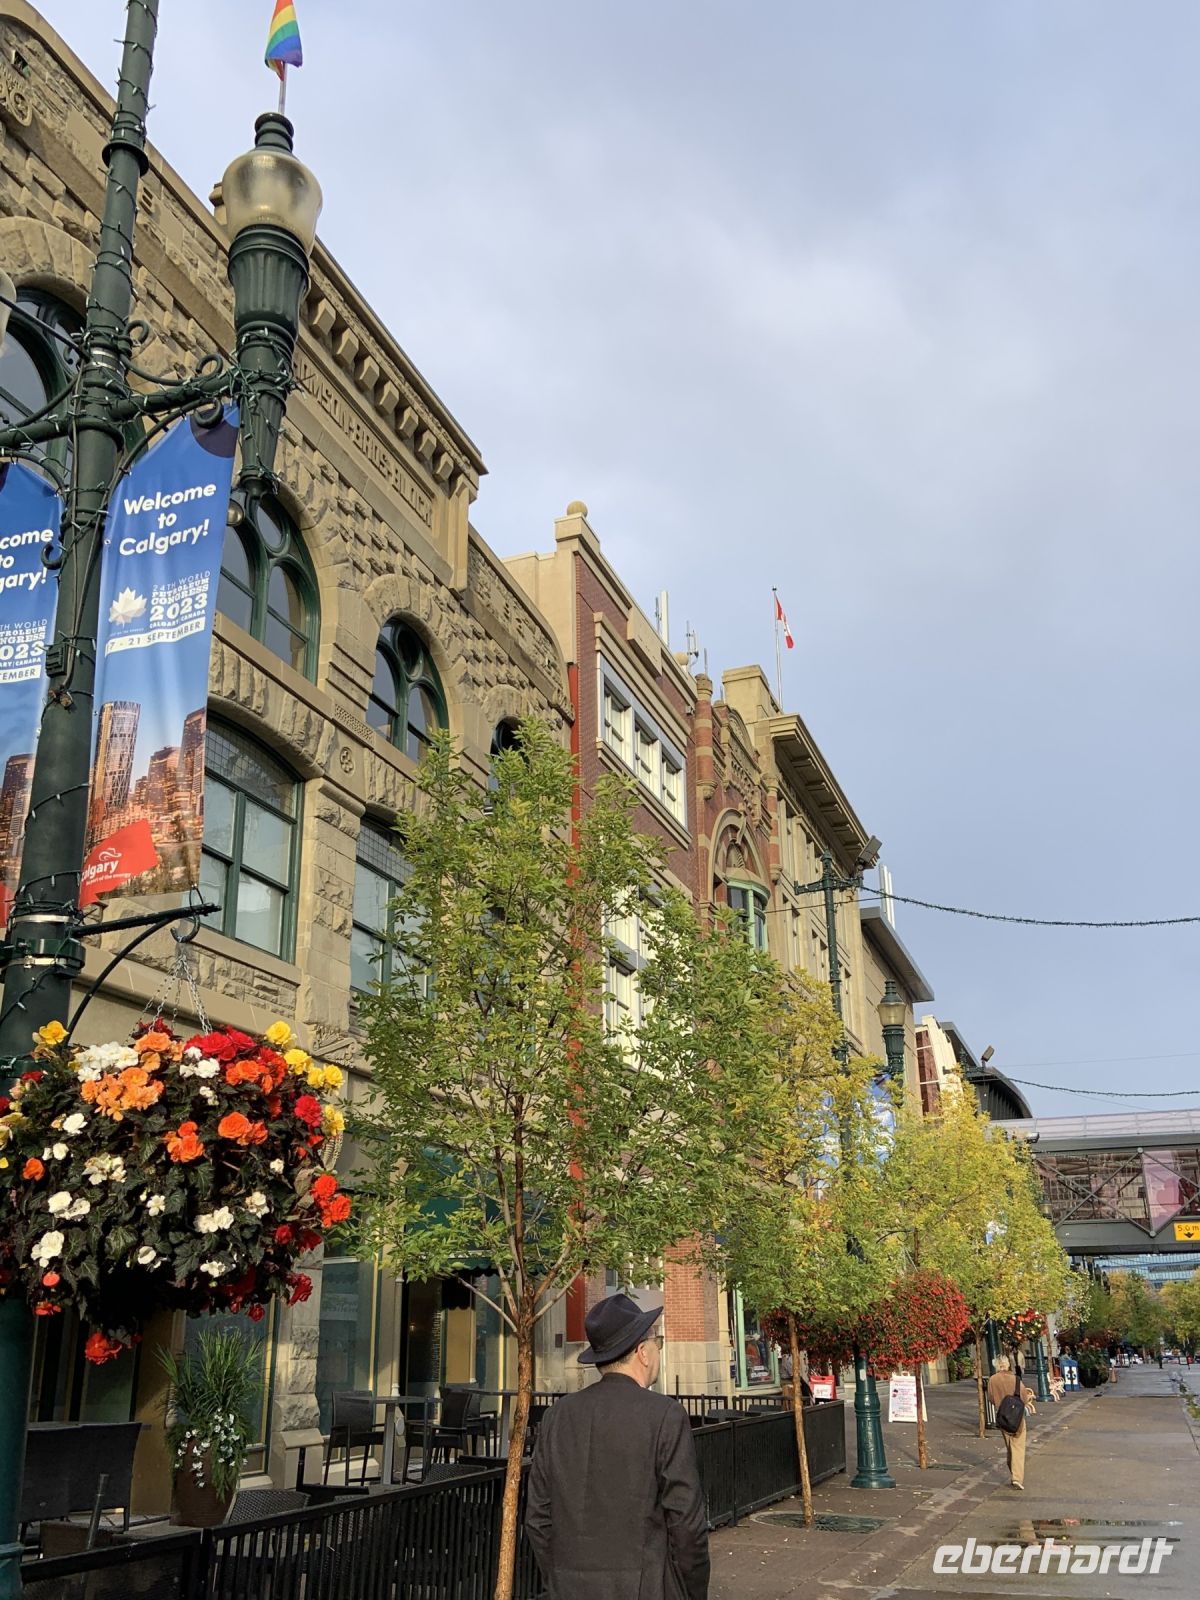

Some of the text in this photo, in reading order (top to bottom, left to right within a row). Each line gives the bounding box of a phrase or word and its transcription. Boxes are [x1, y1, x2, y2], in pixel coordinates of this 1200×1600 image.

[123, 483, 216, 515] Welcome
[157, 512, 177, 529] to
[0, 529, 54, 550] come
[119, 518, 209, 556] Calgary!
[151, 577, 209, 598] PETROLEUM
[152, 570, 211, 592] 24TH WORLD
[151, 583, 209, 606] CONGRESS
[149, 592, 208, 622] 2023
[14, 618, 48, 630] WORLD
[149, 609, 206, 629] CALGARY CANADA
[128, 637, 141, 646] 21
[147, 621, 201, 643] SEPTEMBER
[15, 656, 42, 667] CANADA
[0, 668, 36, 681] EMBER
